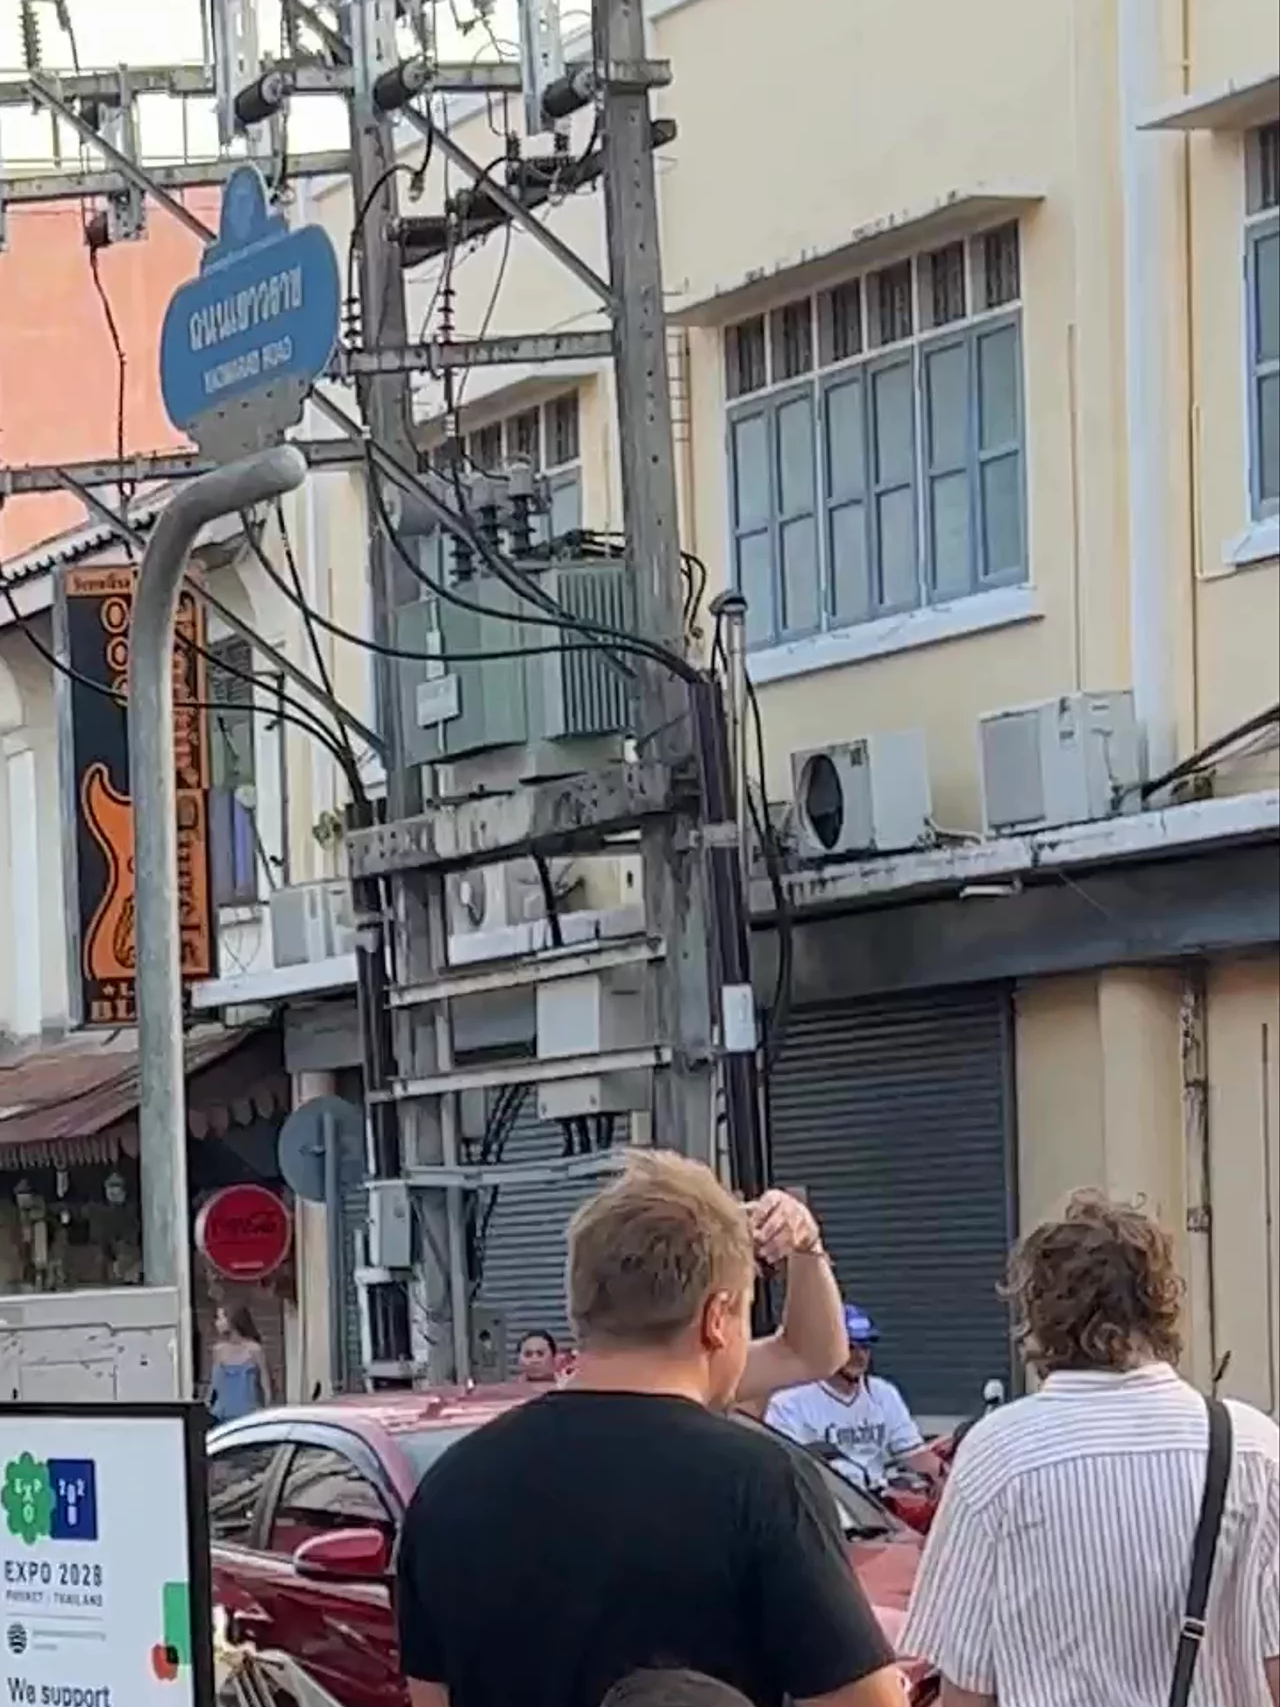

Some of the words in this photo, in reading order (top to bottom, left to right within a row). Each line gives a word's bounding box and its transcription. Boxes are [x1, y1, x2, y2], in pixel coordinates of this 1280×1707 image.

[4, 1560, 51, 1584] EXPO
[58, 1562, 103, 1587] 2028
[7, 1676, 35, 1703] We
